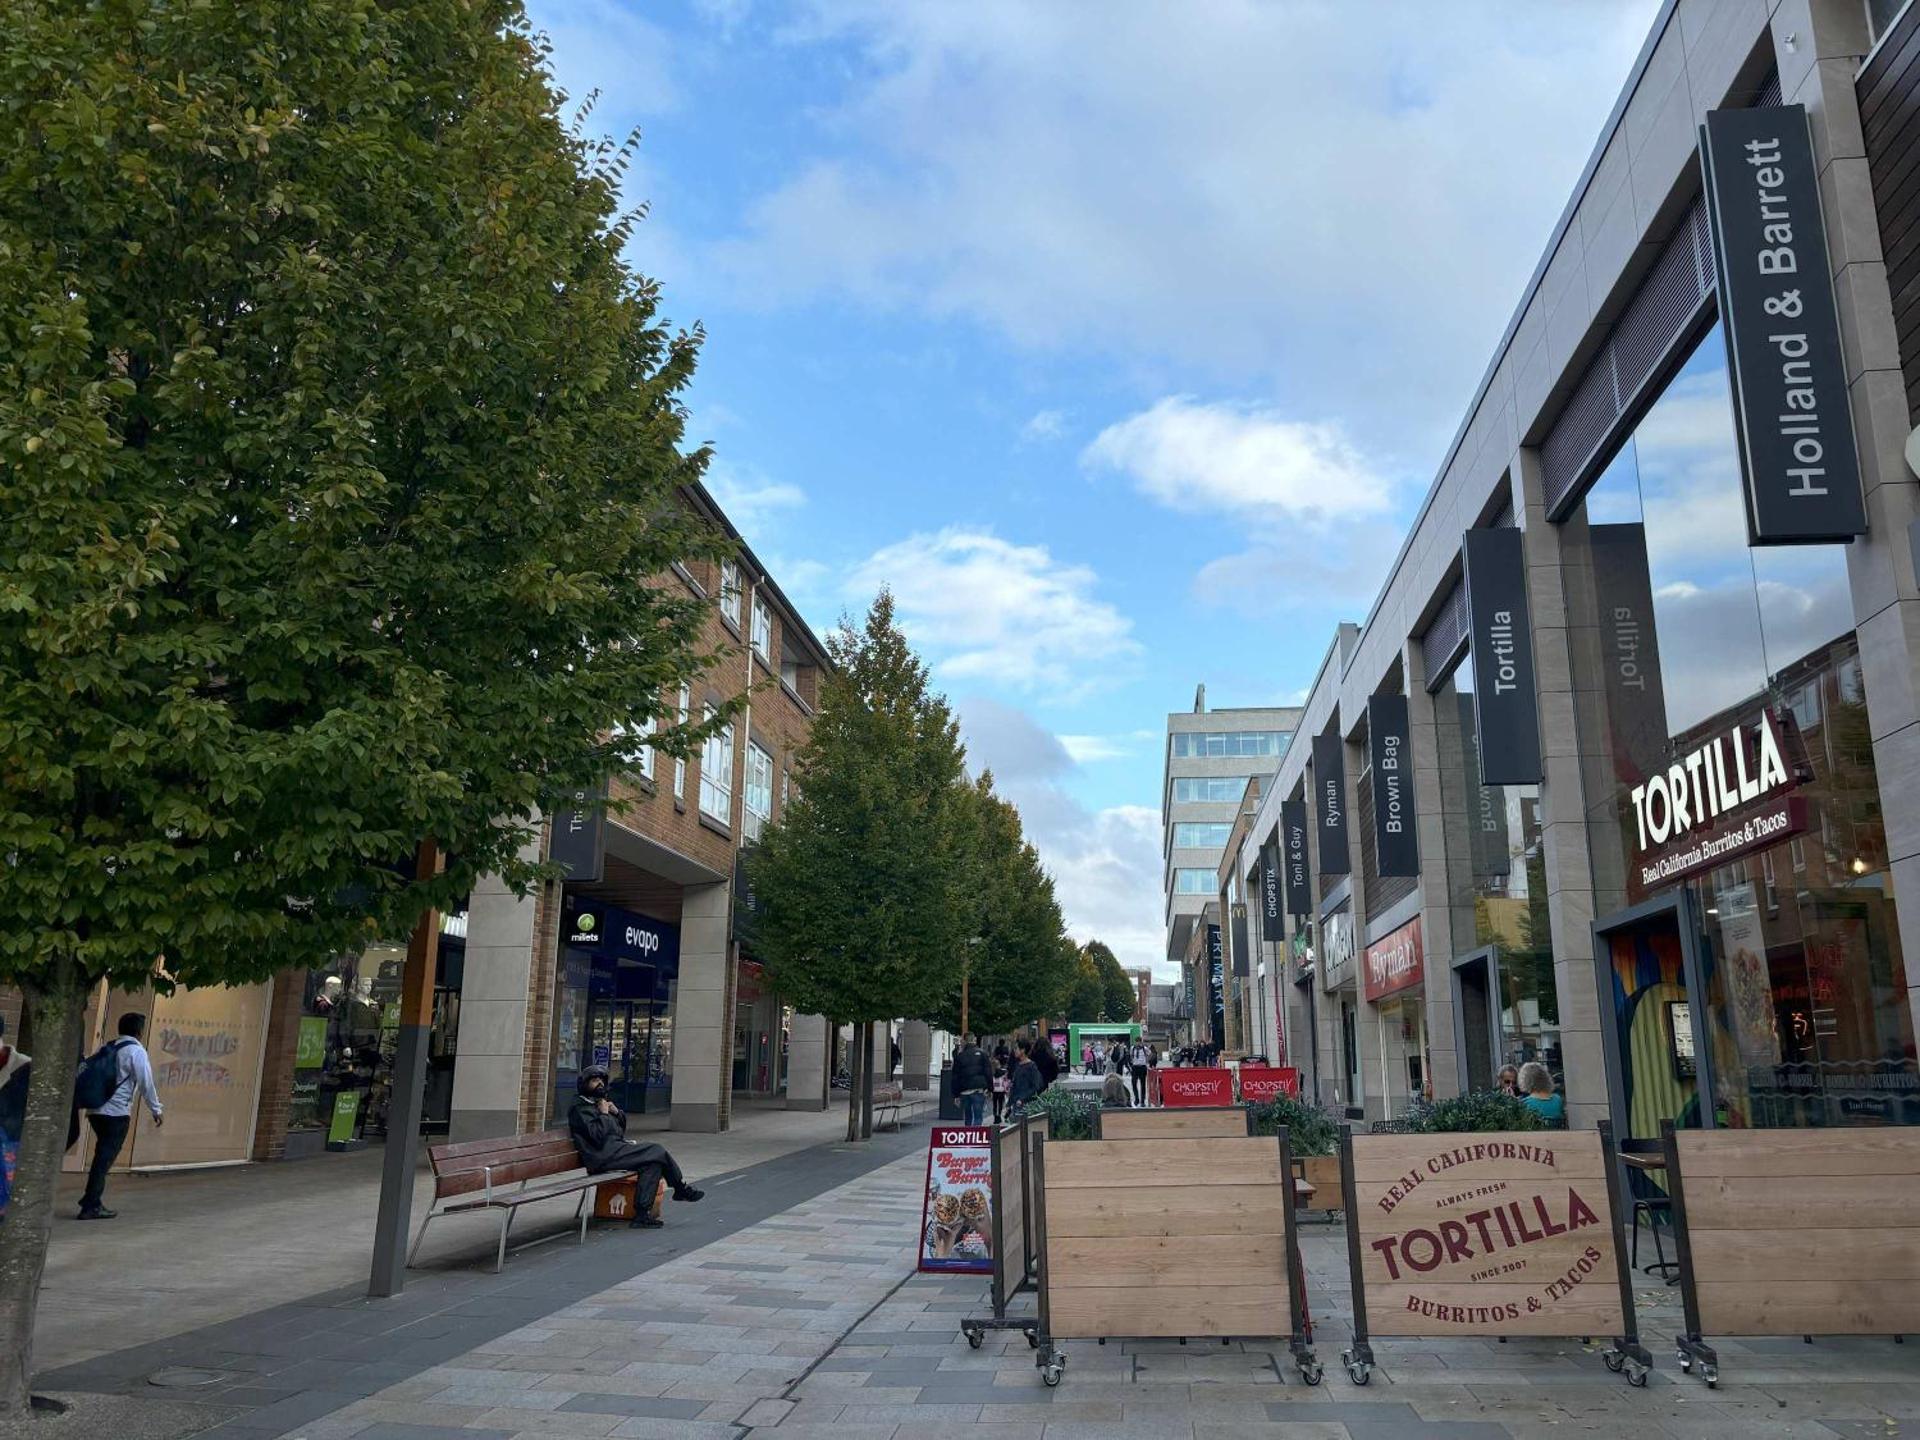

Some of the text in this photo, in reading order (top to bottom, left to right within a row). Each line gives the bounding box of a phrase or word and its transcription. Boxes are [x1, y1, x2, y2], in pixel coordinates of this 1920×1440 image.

[1744, 137, 1829, 498] Holland & Barrett
[1490, 611, 1517, 695] Tortilla
[1326, 780, 1341, 827] Ryman
[1382, 735, 1403, 833] Brown Bag
[1631, 708, 1788, 851] TORTILLA
[1291, 826, 1304, 888] Toni & Guy
[1641, 810, 1788, 885] Real California Burritos & Tacos
[1266, 868, 1277, 918] CHOPSTIX
[571, 933, 599, 942] millets
[625, 925, 659, 957] evapo
[1371, 938, 1418, 989] Ryman
[1211, 930, 1226, 1014] PRIMARK
[941, 1131, 989, 1144] TORTILL
[1378, 1142, 1556, 1215] REAL CALIFORNIA
[1436, 1181, 1507, 1209] ALWAYS FRESH
[1371, 1186, 1600, 1281] TORTILLA
[1406, 1245, 1602, 1324] BURRITOS & TACOS
[1470, 1259, 1528, 1282] SINCE 2007
